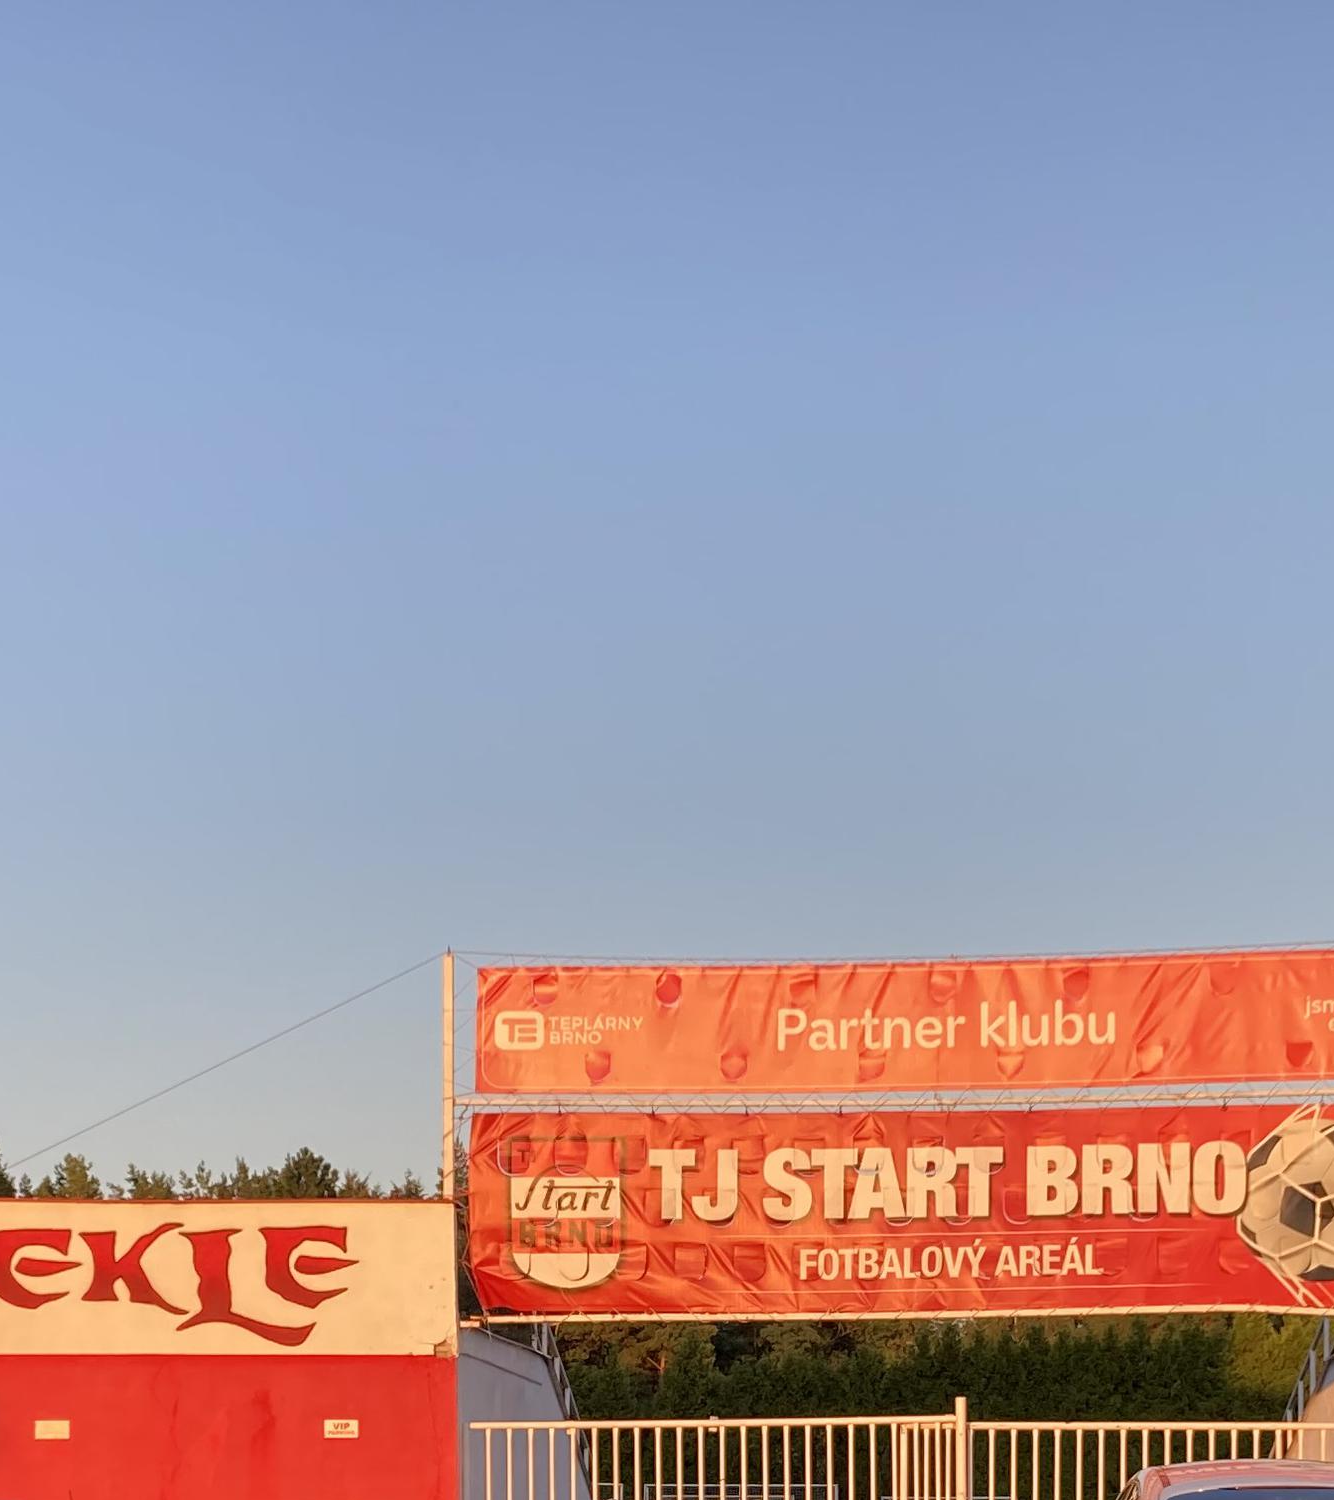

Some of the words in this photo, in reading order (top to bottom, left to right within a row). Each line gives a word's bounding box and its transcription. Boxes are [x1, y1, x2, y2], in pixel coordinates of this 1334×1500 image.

[548, 1013, 644, 1031] TEPLÁRNY
[549, 1031, 603, 1045] BRNO
[776, 1007, 966, 1052] Partner
[979, 999, 1117, 1048] klubu
[514, 1163, 617, 1212] Start
[648, 1147, 740, 1222] TJ
[762, 1146, 1004, 1222] START
[1026, 1139, 1248, 1217] BRNO
[798, 1238, 988, 1281] FOTBALOVÝ
[994, 1236, 1104, 1278] AREÁL
[332, 1421, 351, 1430] VIP
